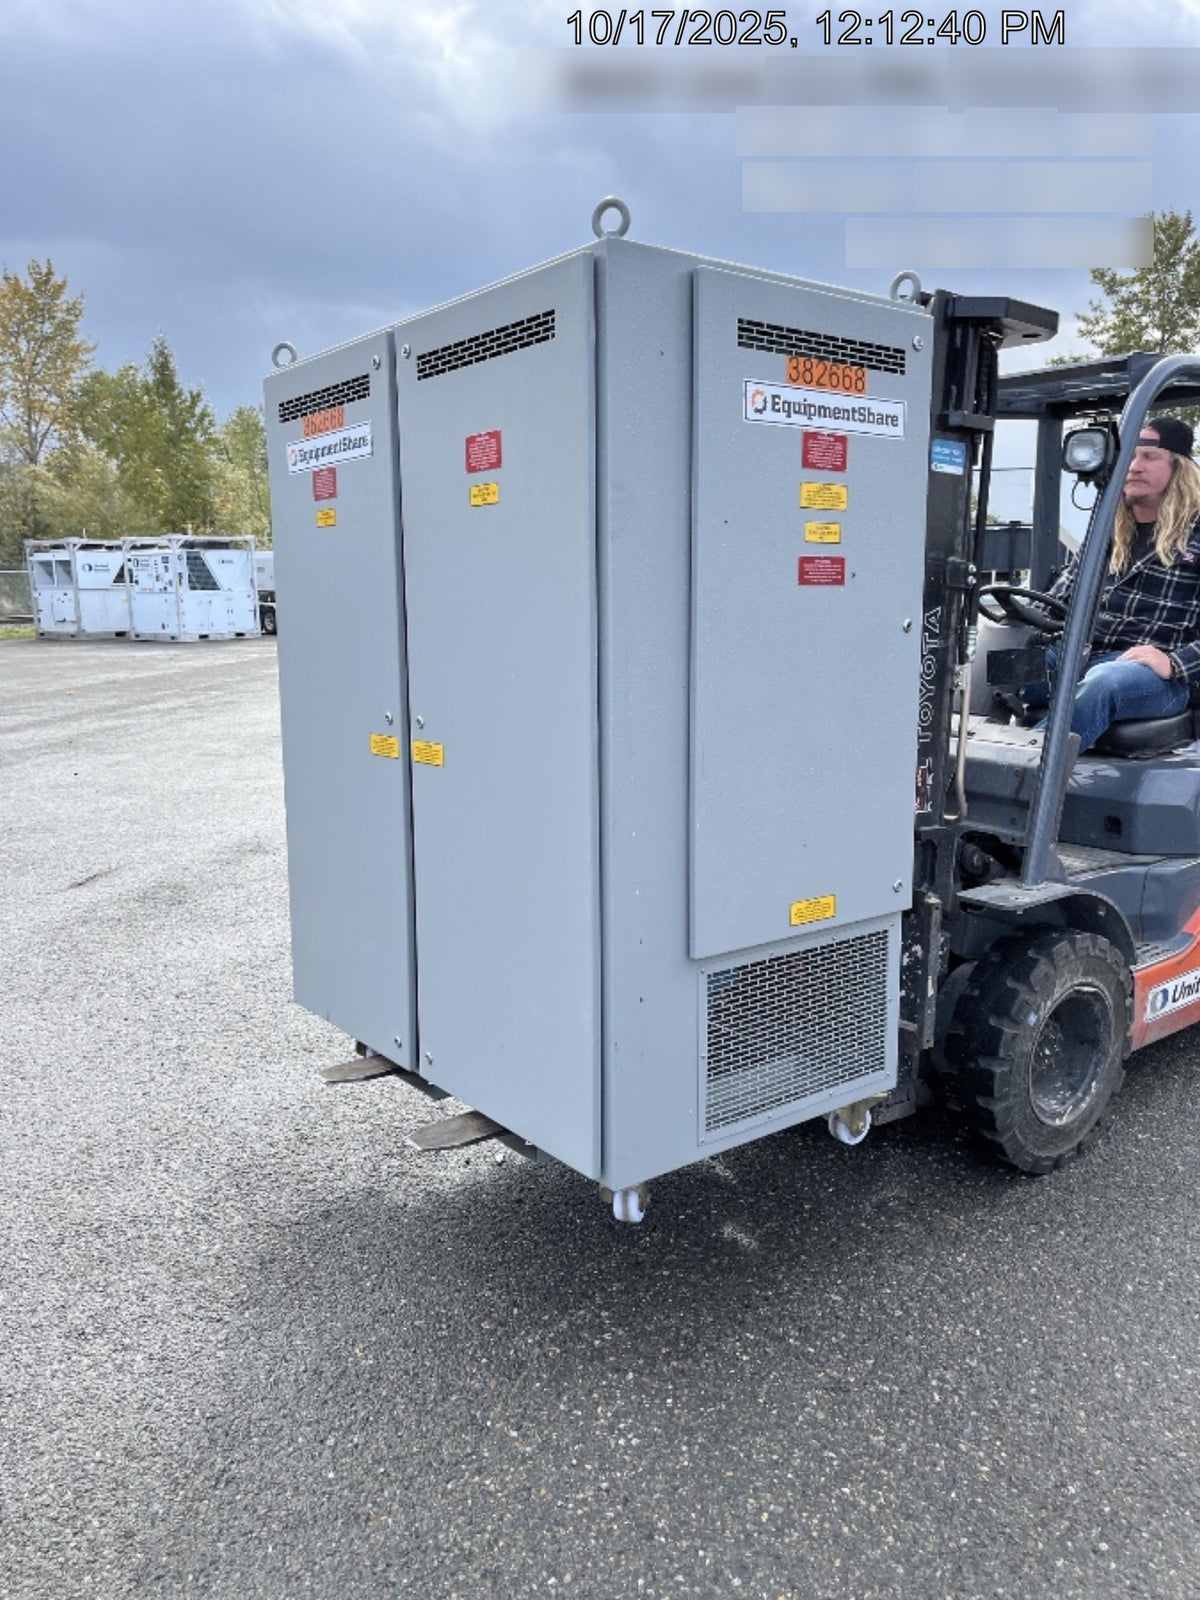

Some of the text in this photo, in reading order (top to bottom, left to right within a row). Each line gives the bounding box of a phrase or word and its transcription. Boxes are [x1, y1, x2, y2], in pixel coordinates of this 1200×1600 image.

[788, 356, 865, 392] 382668
[771, 394, 899, 427] EquipmentShare
[917, 606, 942, 742] TOYOTA
